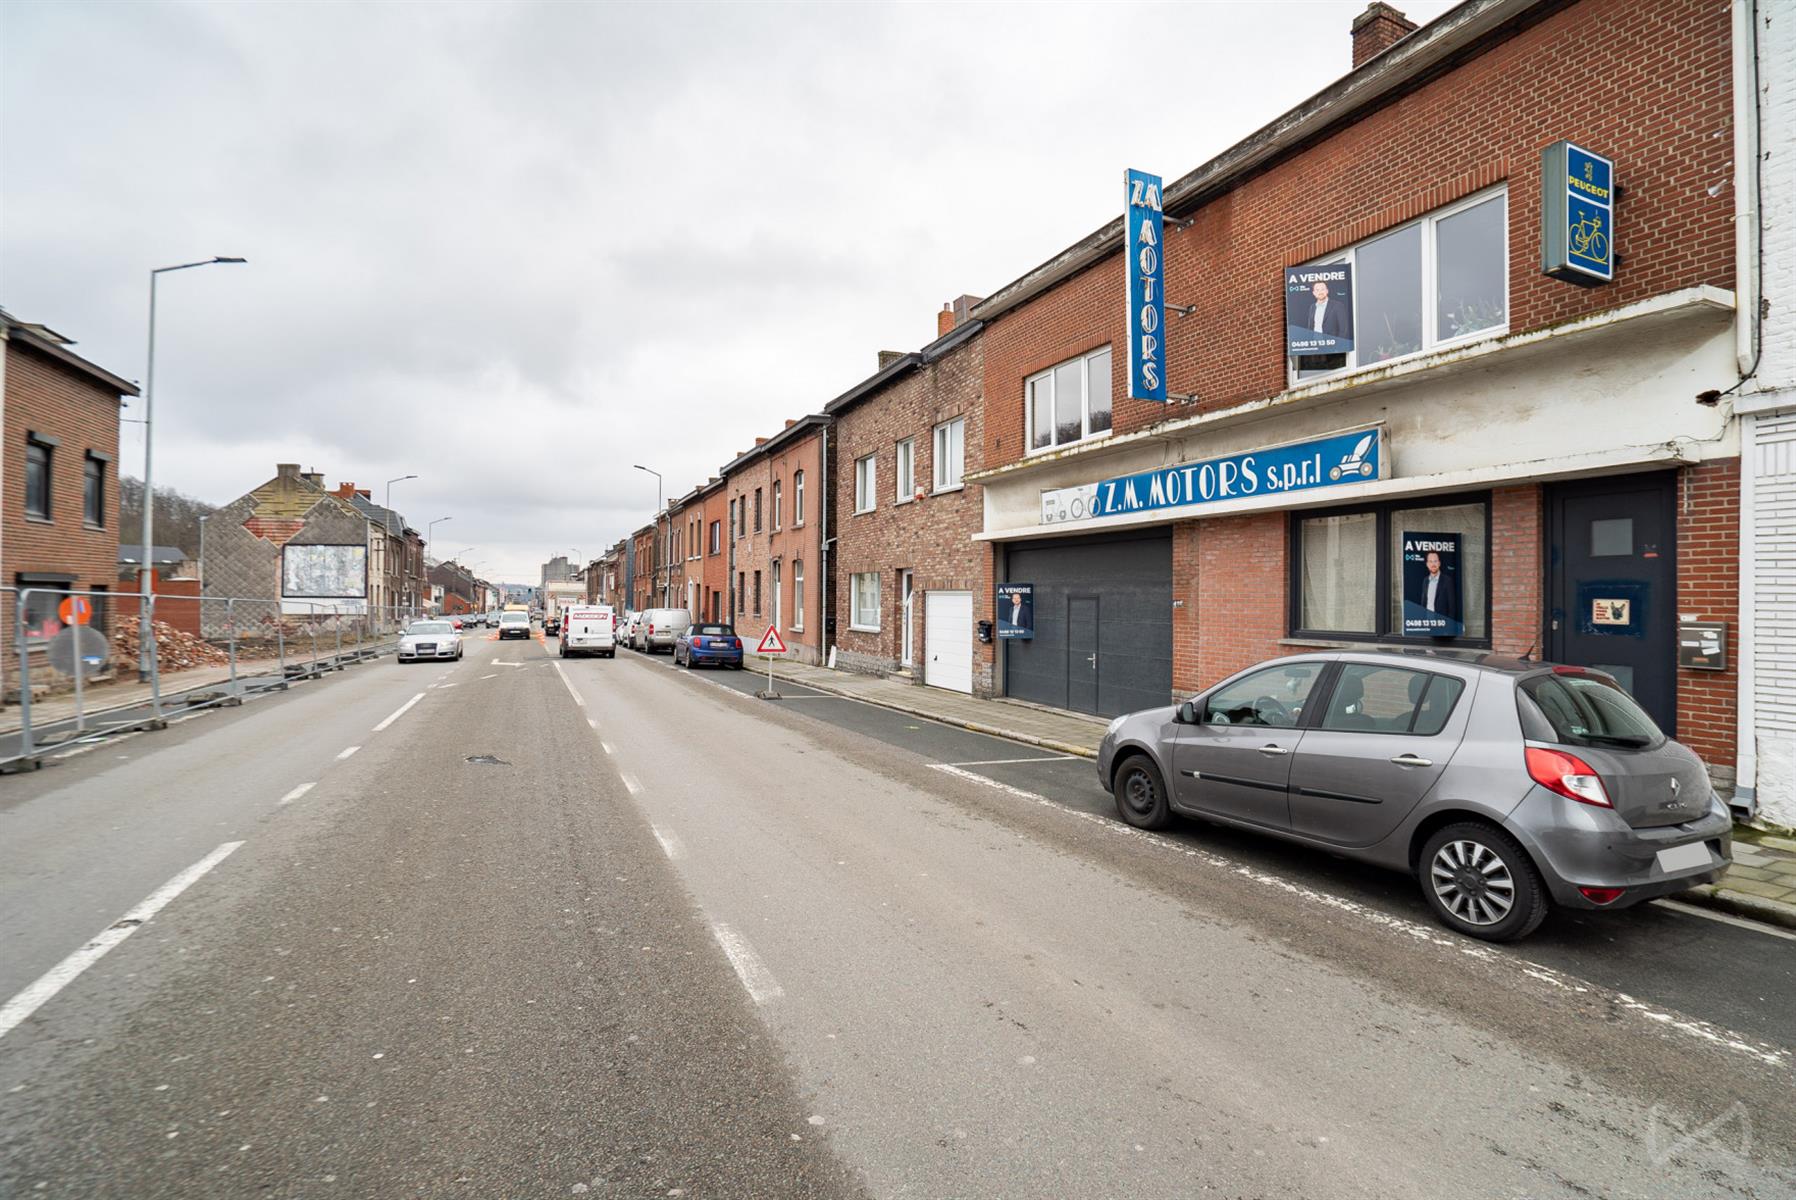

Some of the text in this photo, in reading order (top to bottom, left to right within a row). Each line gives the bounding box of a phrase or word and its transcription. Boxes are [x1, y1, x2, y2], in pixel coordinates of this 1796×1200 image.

[1569, 176, 1608, 198] PEUGEOT
[1289, 271, 1345, 284] A VENDRE
[1138, 219, 1160, 392] MOTORS
[1105, 478, 1143, 513] Z.M.
[1149, 456, 1259, 506] MOTORS
[1405, 540, 1455, 552] A VENDRE
